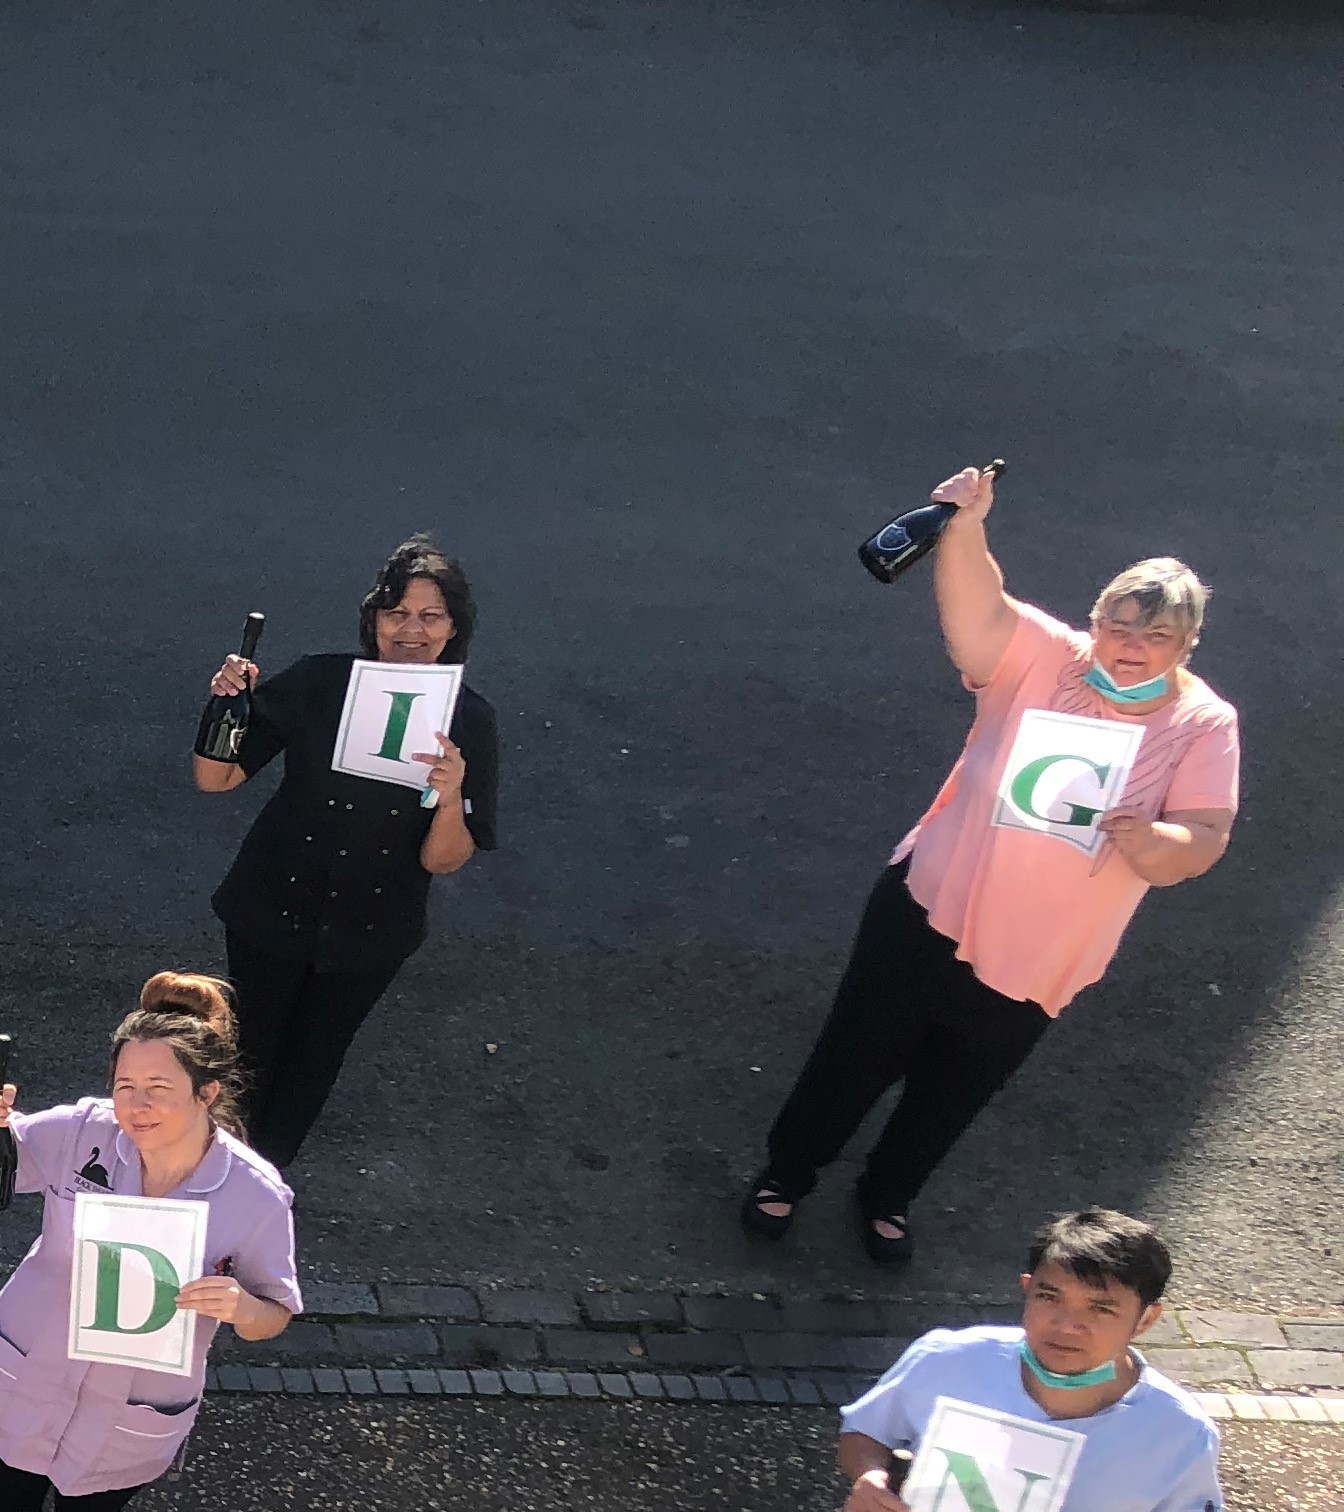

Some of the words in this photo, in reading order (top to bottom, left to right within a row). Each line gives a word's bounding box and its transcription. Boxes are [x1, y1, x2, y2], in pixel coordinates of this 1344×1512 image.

[368, 691, 426, 764] I
[1011, 753, 1111, 826] G
[79, 1239, 179, 1335] D
